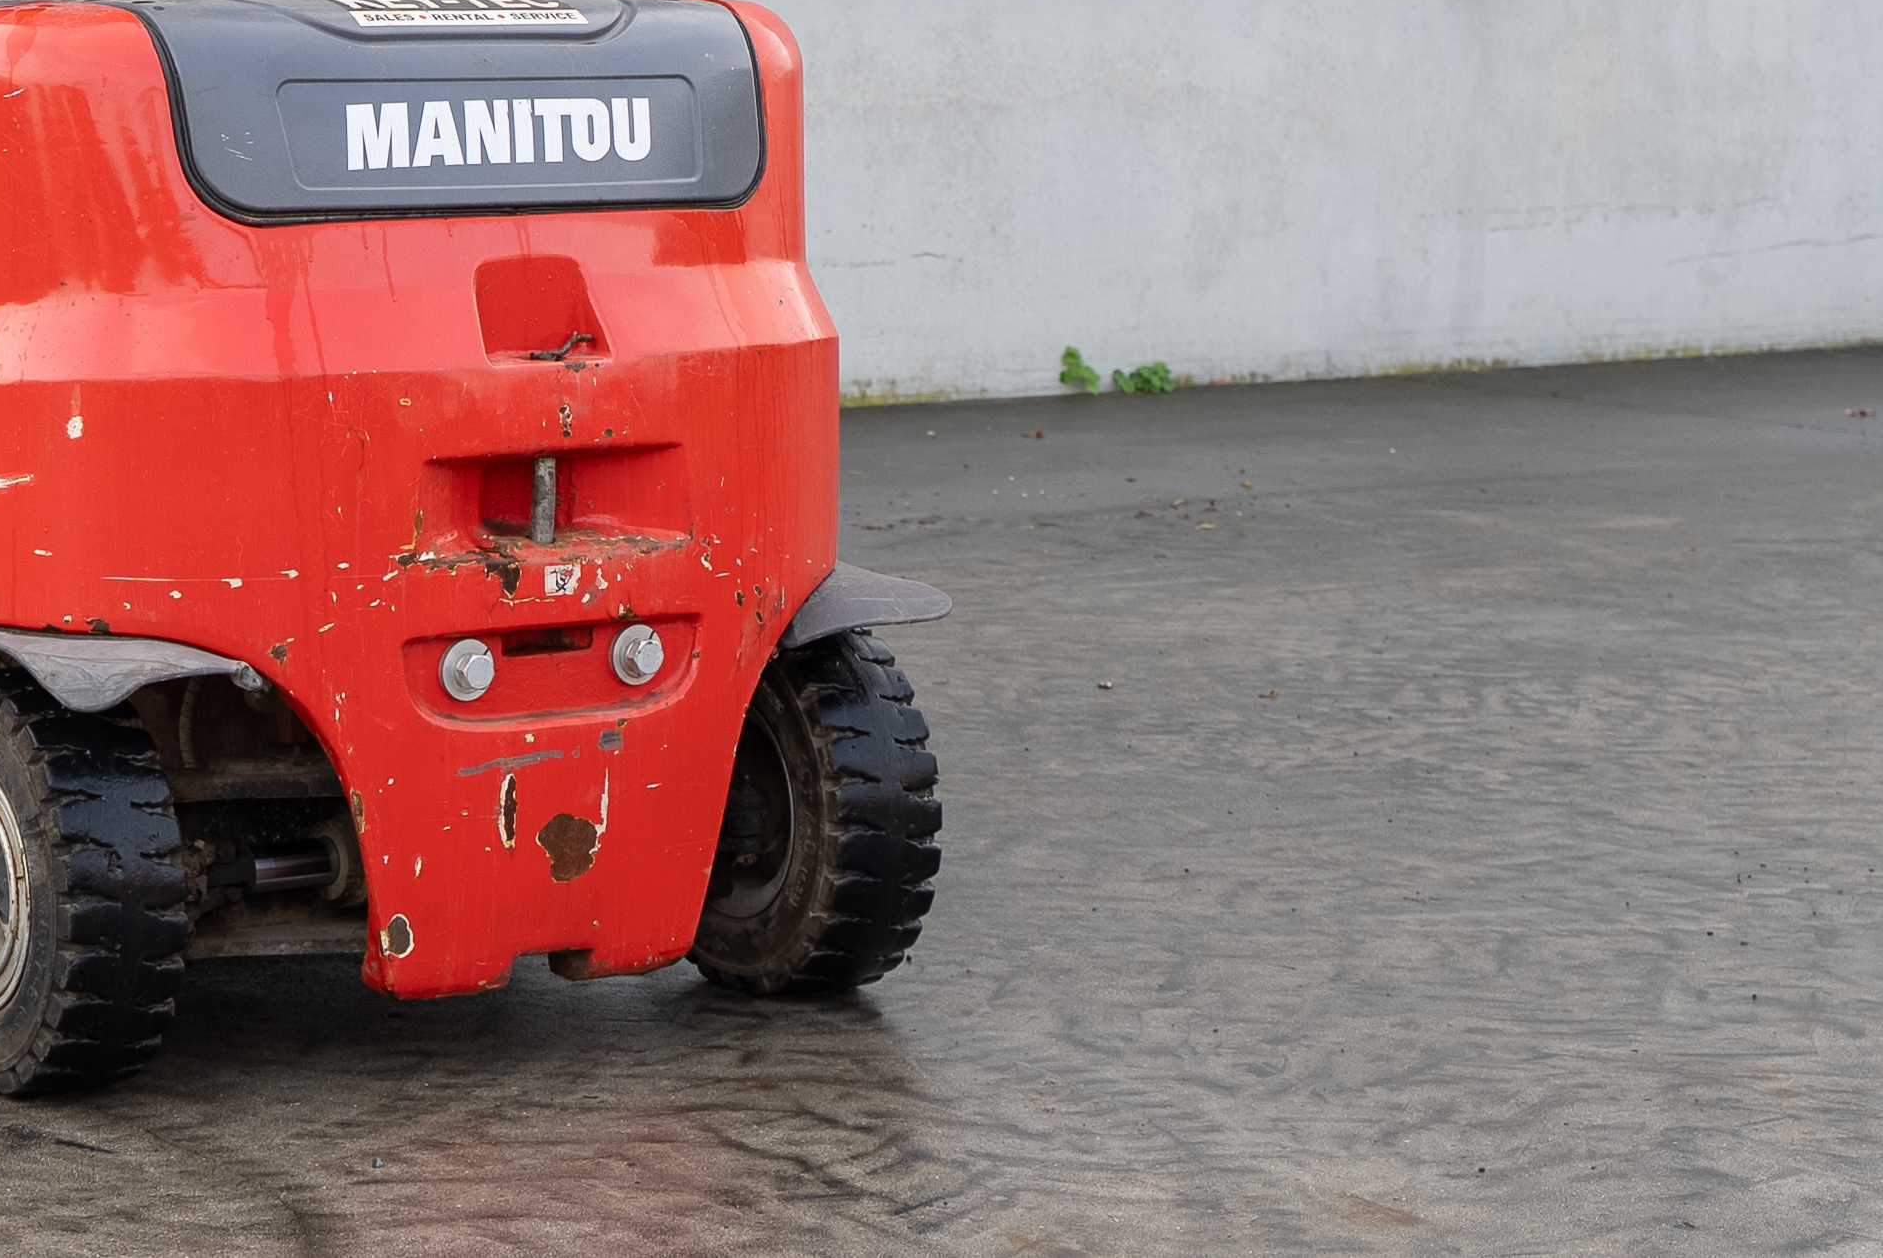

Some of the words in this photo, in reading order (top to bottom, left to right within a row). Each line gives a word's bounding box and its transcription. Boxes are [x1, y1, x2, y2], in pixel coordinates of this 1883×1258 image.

[363, 13, 415, 22] SALES
[432, 13, 495, 21] RENTAL
[510, 12, 578, 20] SERVICE
[345, 97, 652, 171] MANITOU
